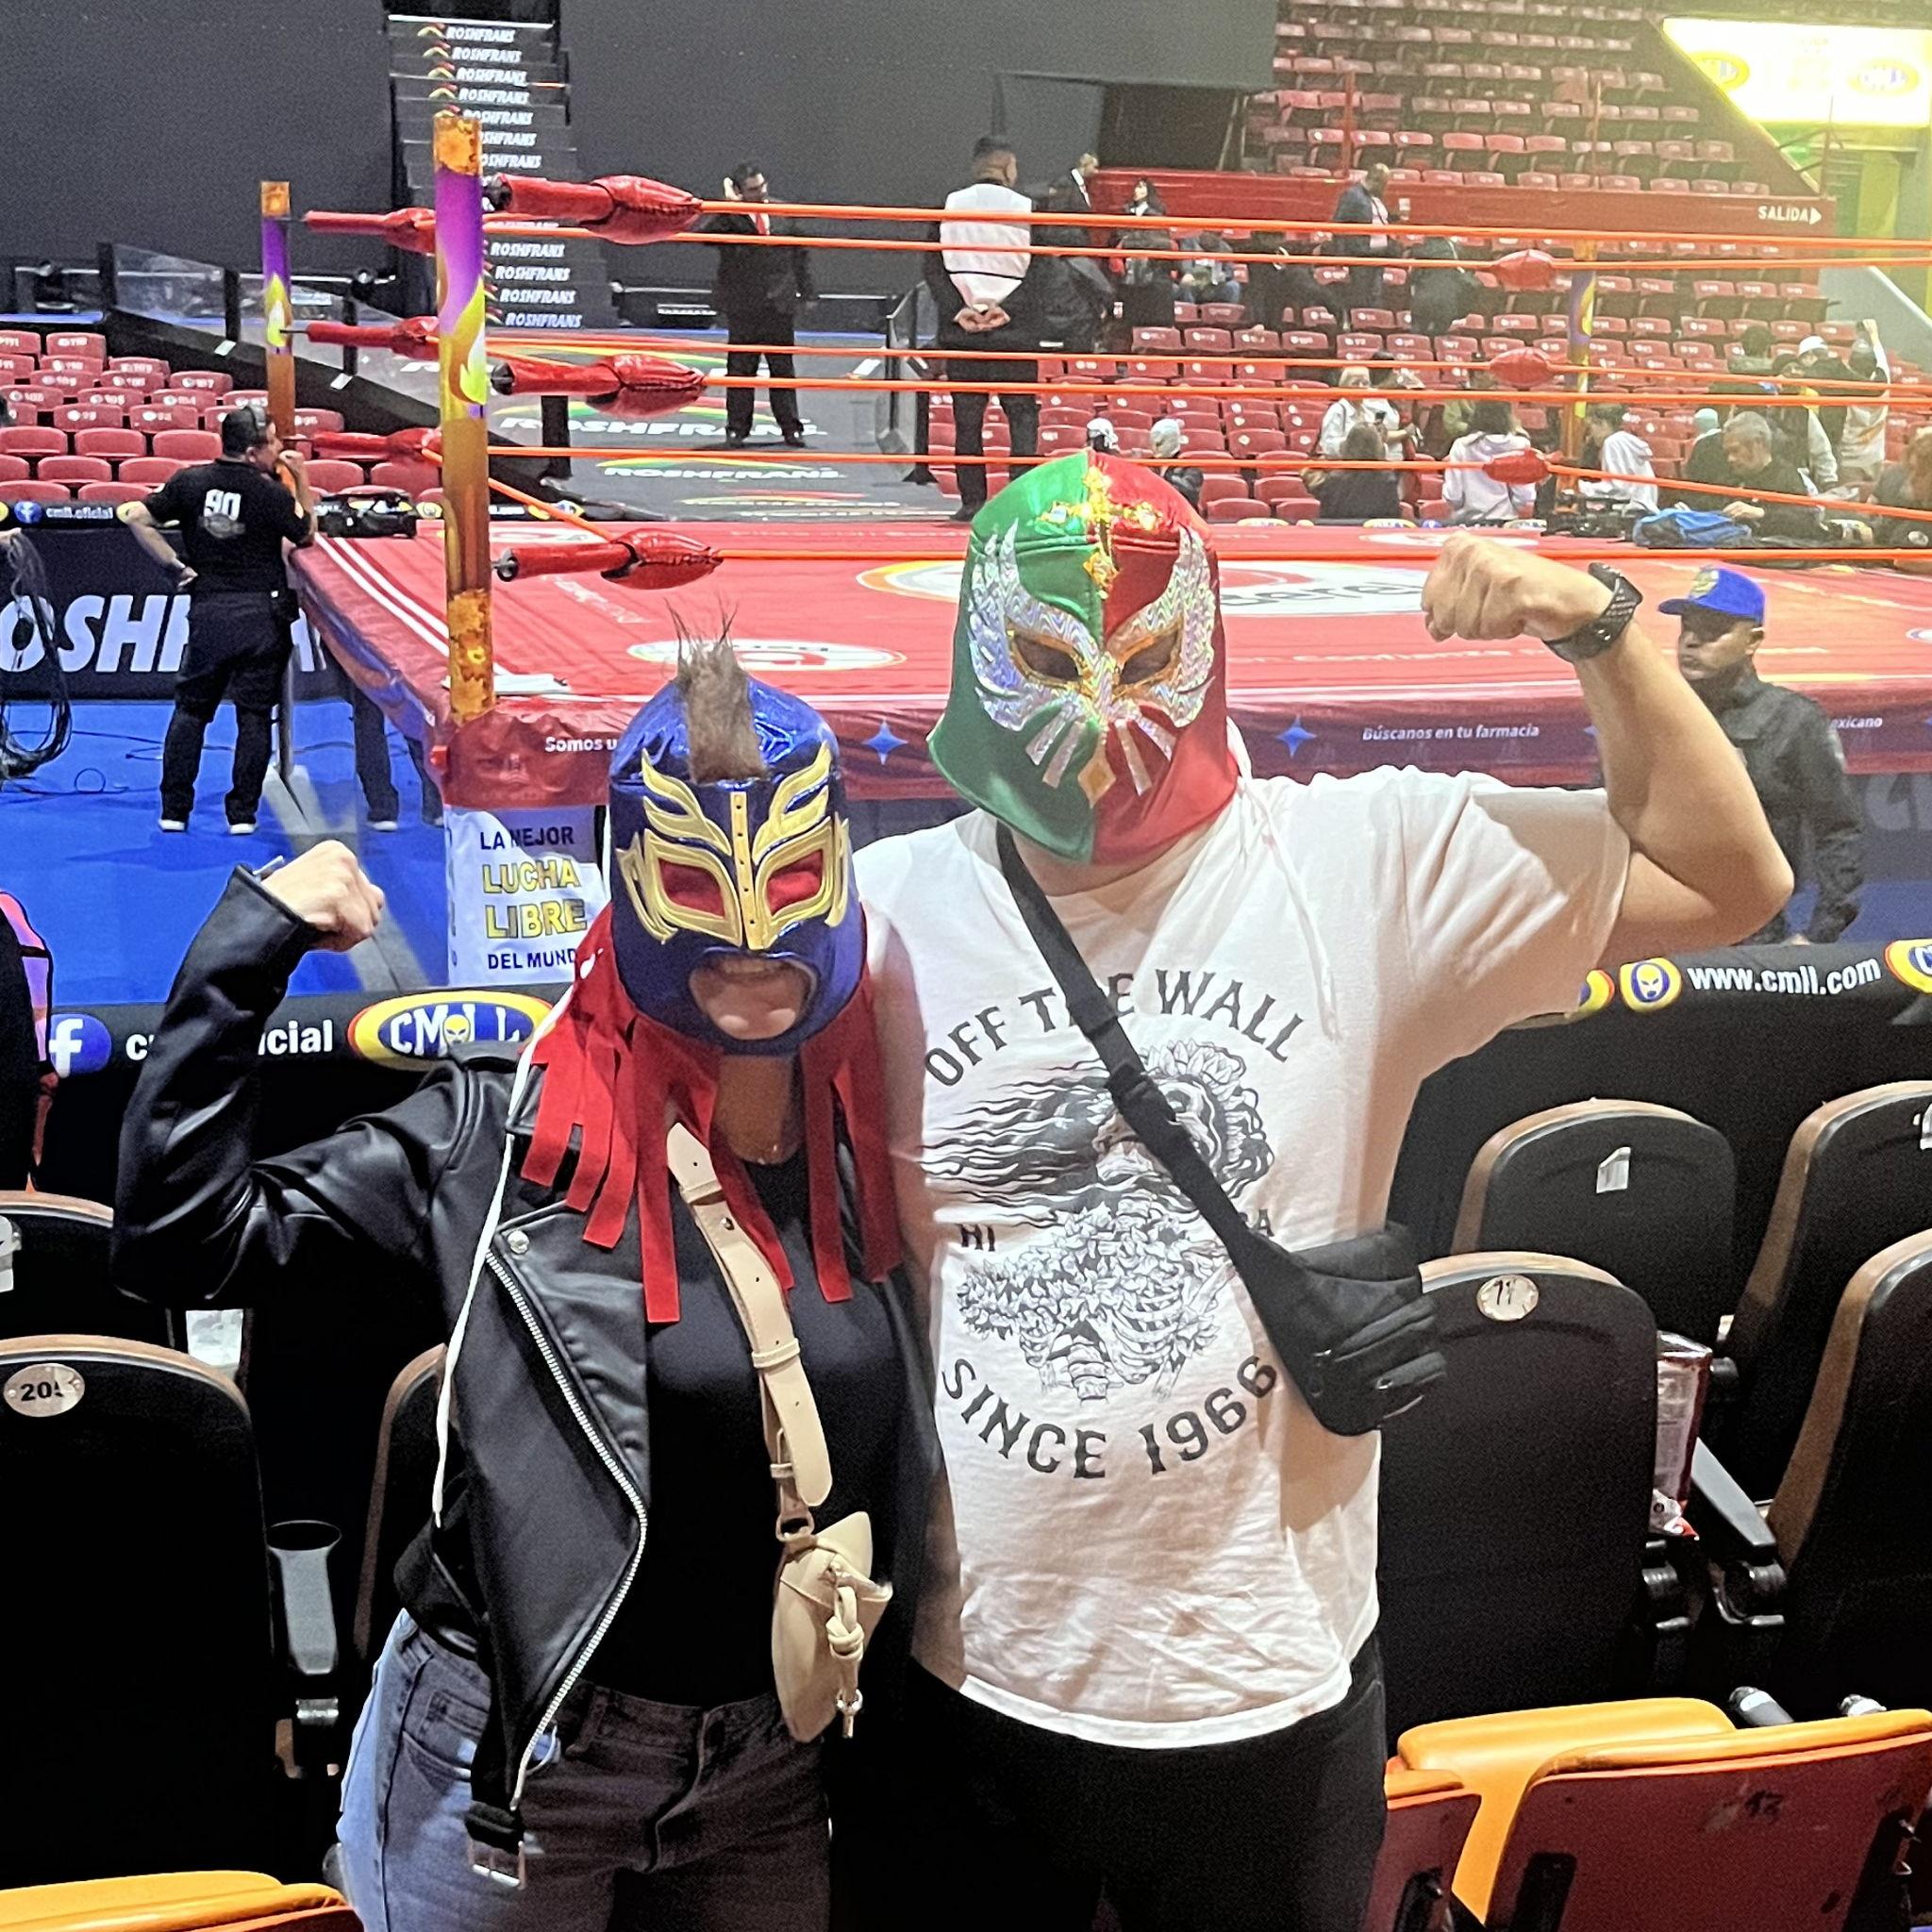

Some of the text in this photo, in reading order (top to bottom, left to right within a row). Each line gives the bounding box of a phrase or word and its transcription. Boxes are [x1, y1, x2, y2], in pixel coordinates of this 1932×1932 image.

[1758, 206, 1808, 223] SALIDA
[491, 242, 565, 258] ROSHFRANS
[495, 265, 571, 281] ROSHFRANS
[500, 289, 576, 304] ROSHFRANS
[505, 312, 582, 327] ROSHFRANS
[1830, 715, 1883, 729] exicano
[1362, 723, 1541, 741] Búscanos en tu farmacia
[544, 736, 603, 753] Somos
[480, 831, 506, 850] LA
[482, 859, 581, 894] LUCHA
[485, 898, 587, 940] LIBRE
[488, 948, 576, 970] DEL MUND
[1687, 958, 1882, 994] www.cmll.com
[924, 969, 1304, 1087] OFF TE WALL
[941, 1356, 1277, 1479] SINCE 1966
